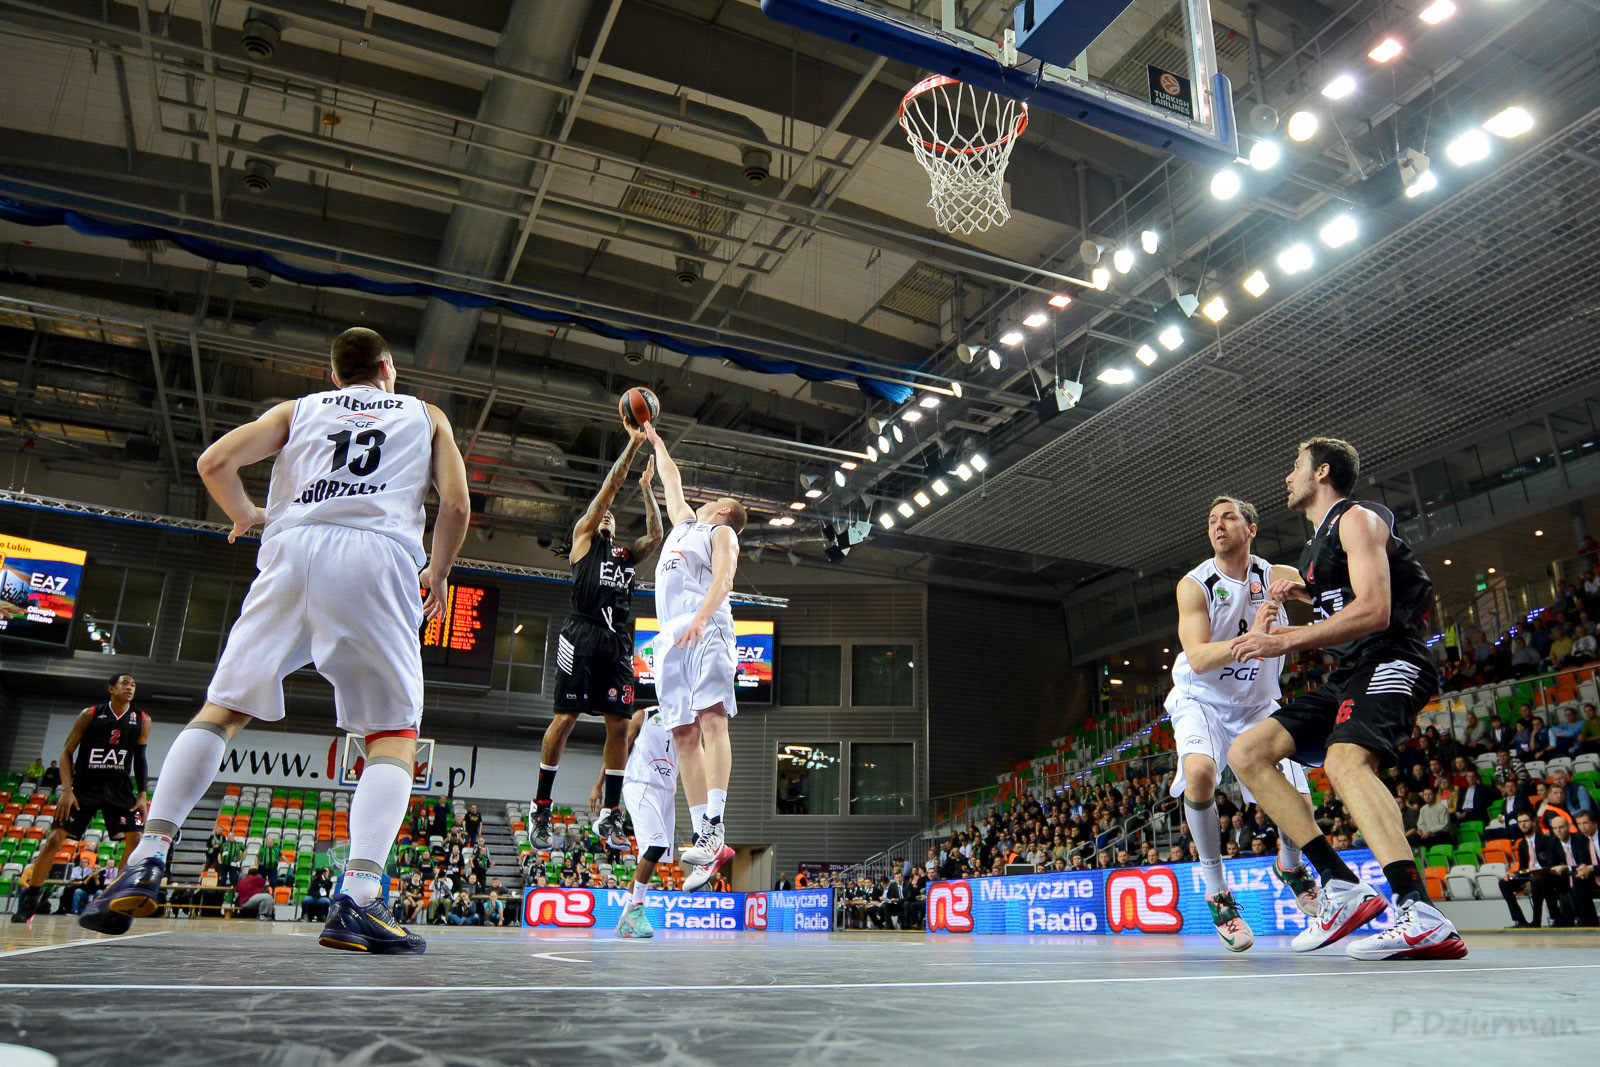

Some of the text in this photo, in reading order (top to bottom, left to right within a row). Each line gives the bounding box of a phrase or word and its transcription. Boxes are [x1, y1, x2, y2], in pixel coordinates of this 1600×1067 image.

[1154, 89, 1190, 108] TURKISH
[1155, 97, 1190, 115] AIRLINES
[322, 395, 404, 412] DYLEWICZ
[326, 428, 387, 477] 13
[6, 541, 31, 552] Lubin
[30, 572, 69, 591] EA7
[599, 561, 636, 584] EA7
[27, 605, 56, 617] Olimpia
[27, 613, 53, 624] Milano
[1237, 618, 1248, 636] 8
[737, 646, 764, 659] EA7
[1219, 666, 1259, 681] PGE
[1336, 699, 1354, 724] 6
[109, 729, 120, 744] 2
[89, 748, 128, 765] EA7
[980, 878, 1094, 905] Muzyczne
[772, 892, 829, 911] Muzyczne
[664, 912, 736, 929] Radio
[794, 912, 829, 930] Radio
[1027, 906, 1098, 931] Radio
